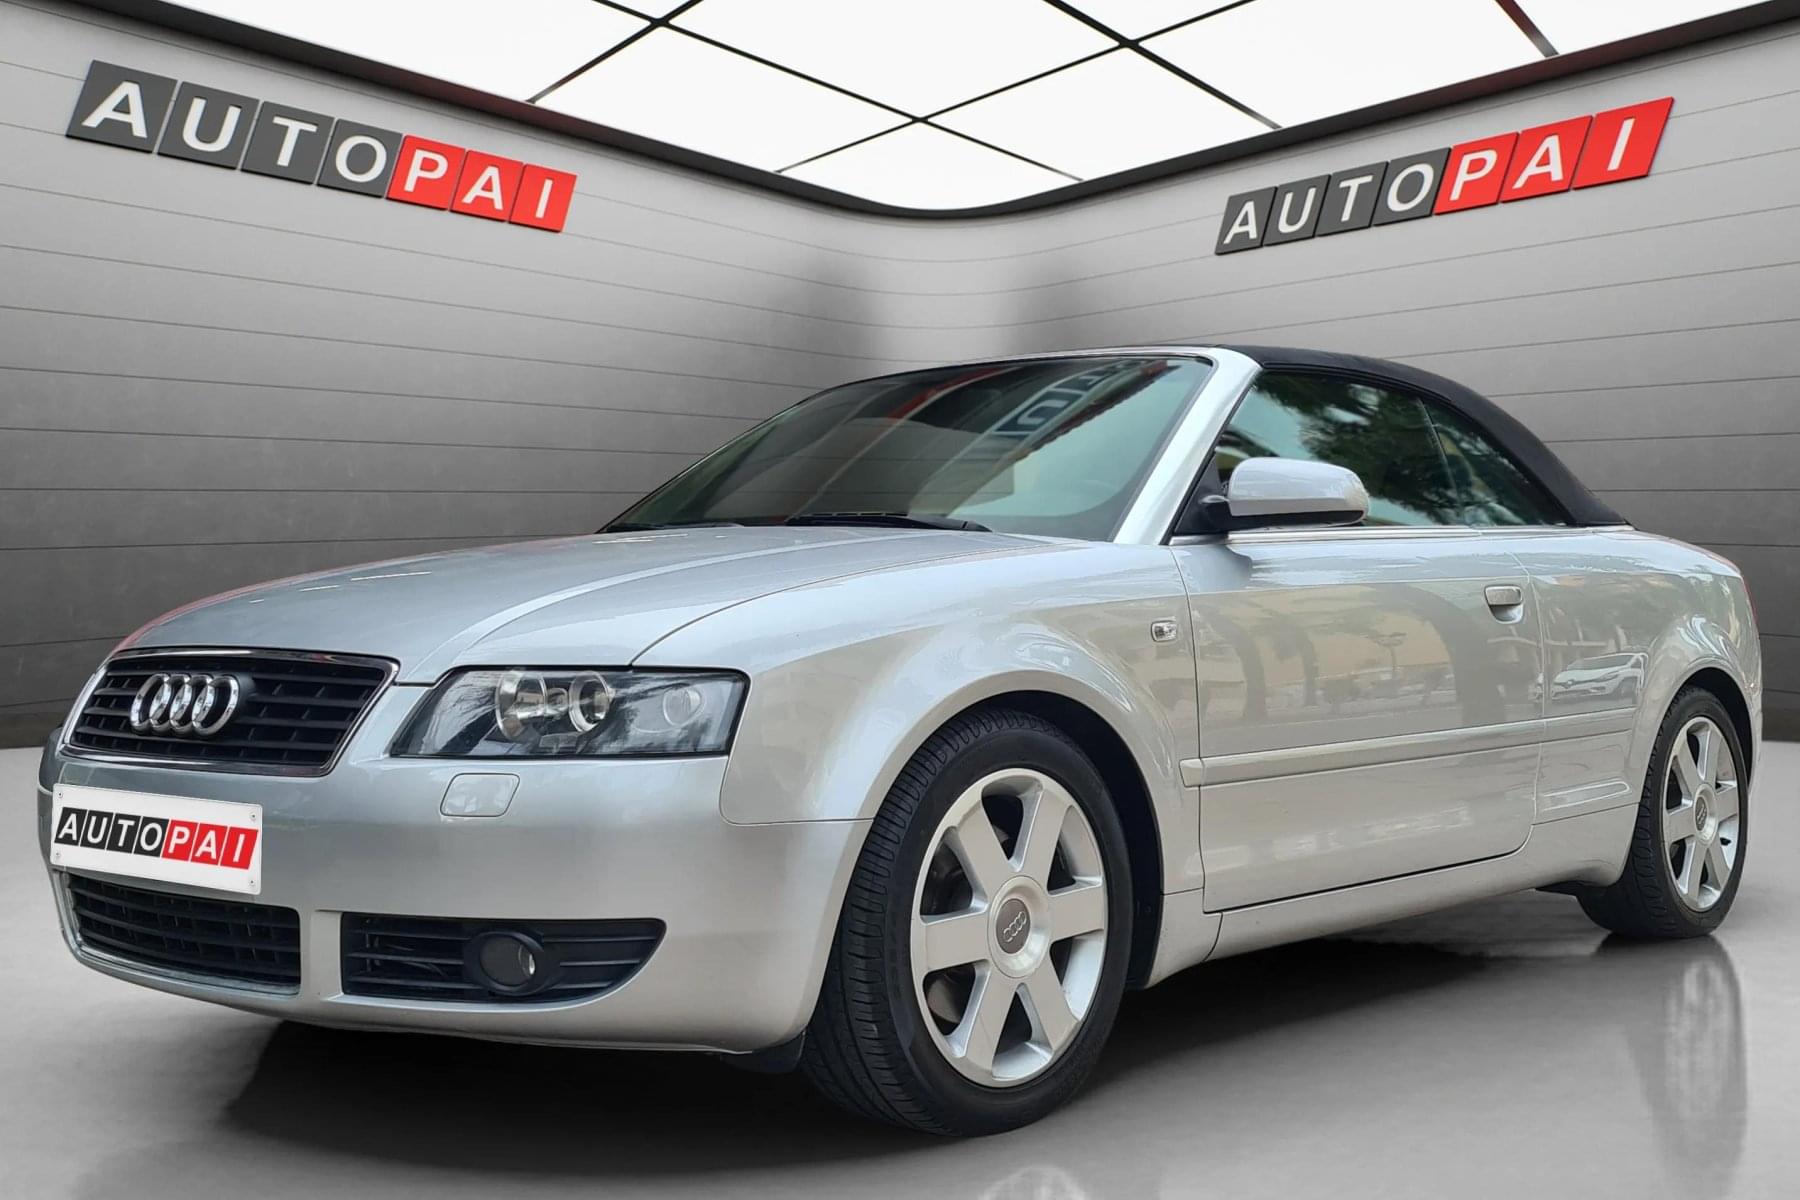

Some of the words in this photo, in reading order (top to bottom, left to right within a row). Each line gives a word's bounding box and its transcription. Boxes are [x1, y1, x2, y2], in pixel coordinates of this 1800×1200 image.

[82, 81, 555, 219] AUTOPAI
[1222, 117, 1636, 245] AUTOPAI
[58, 813, 246, 864] AUTOPAI
